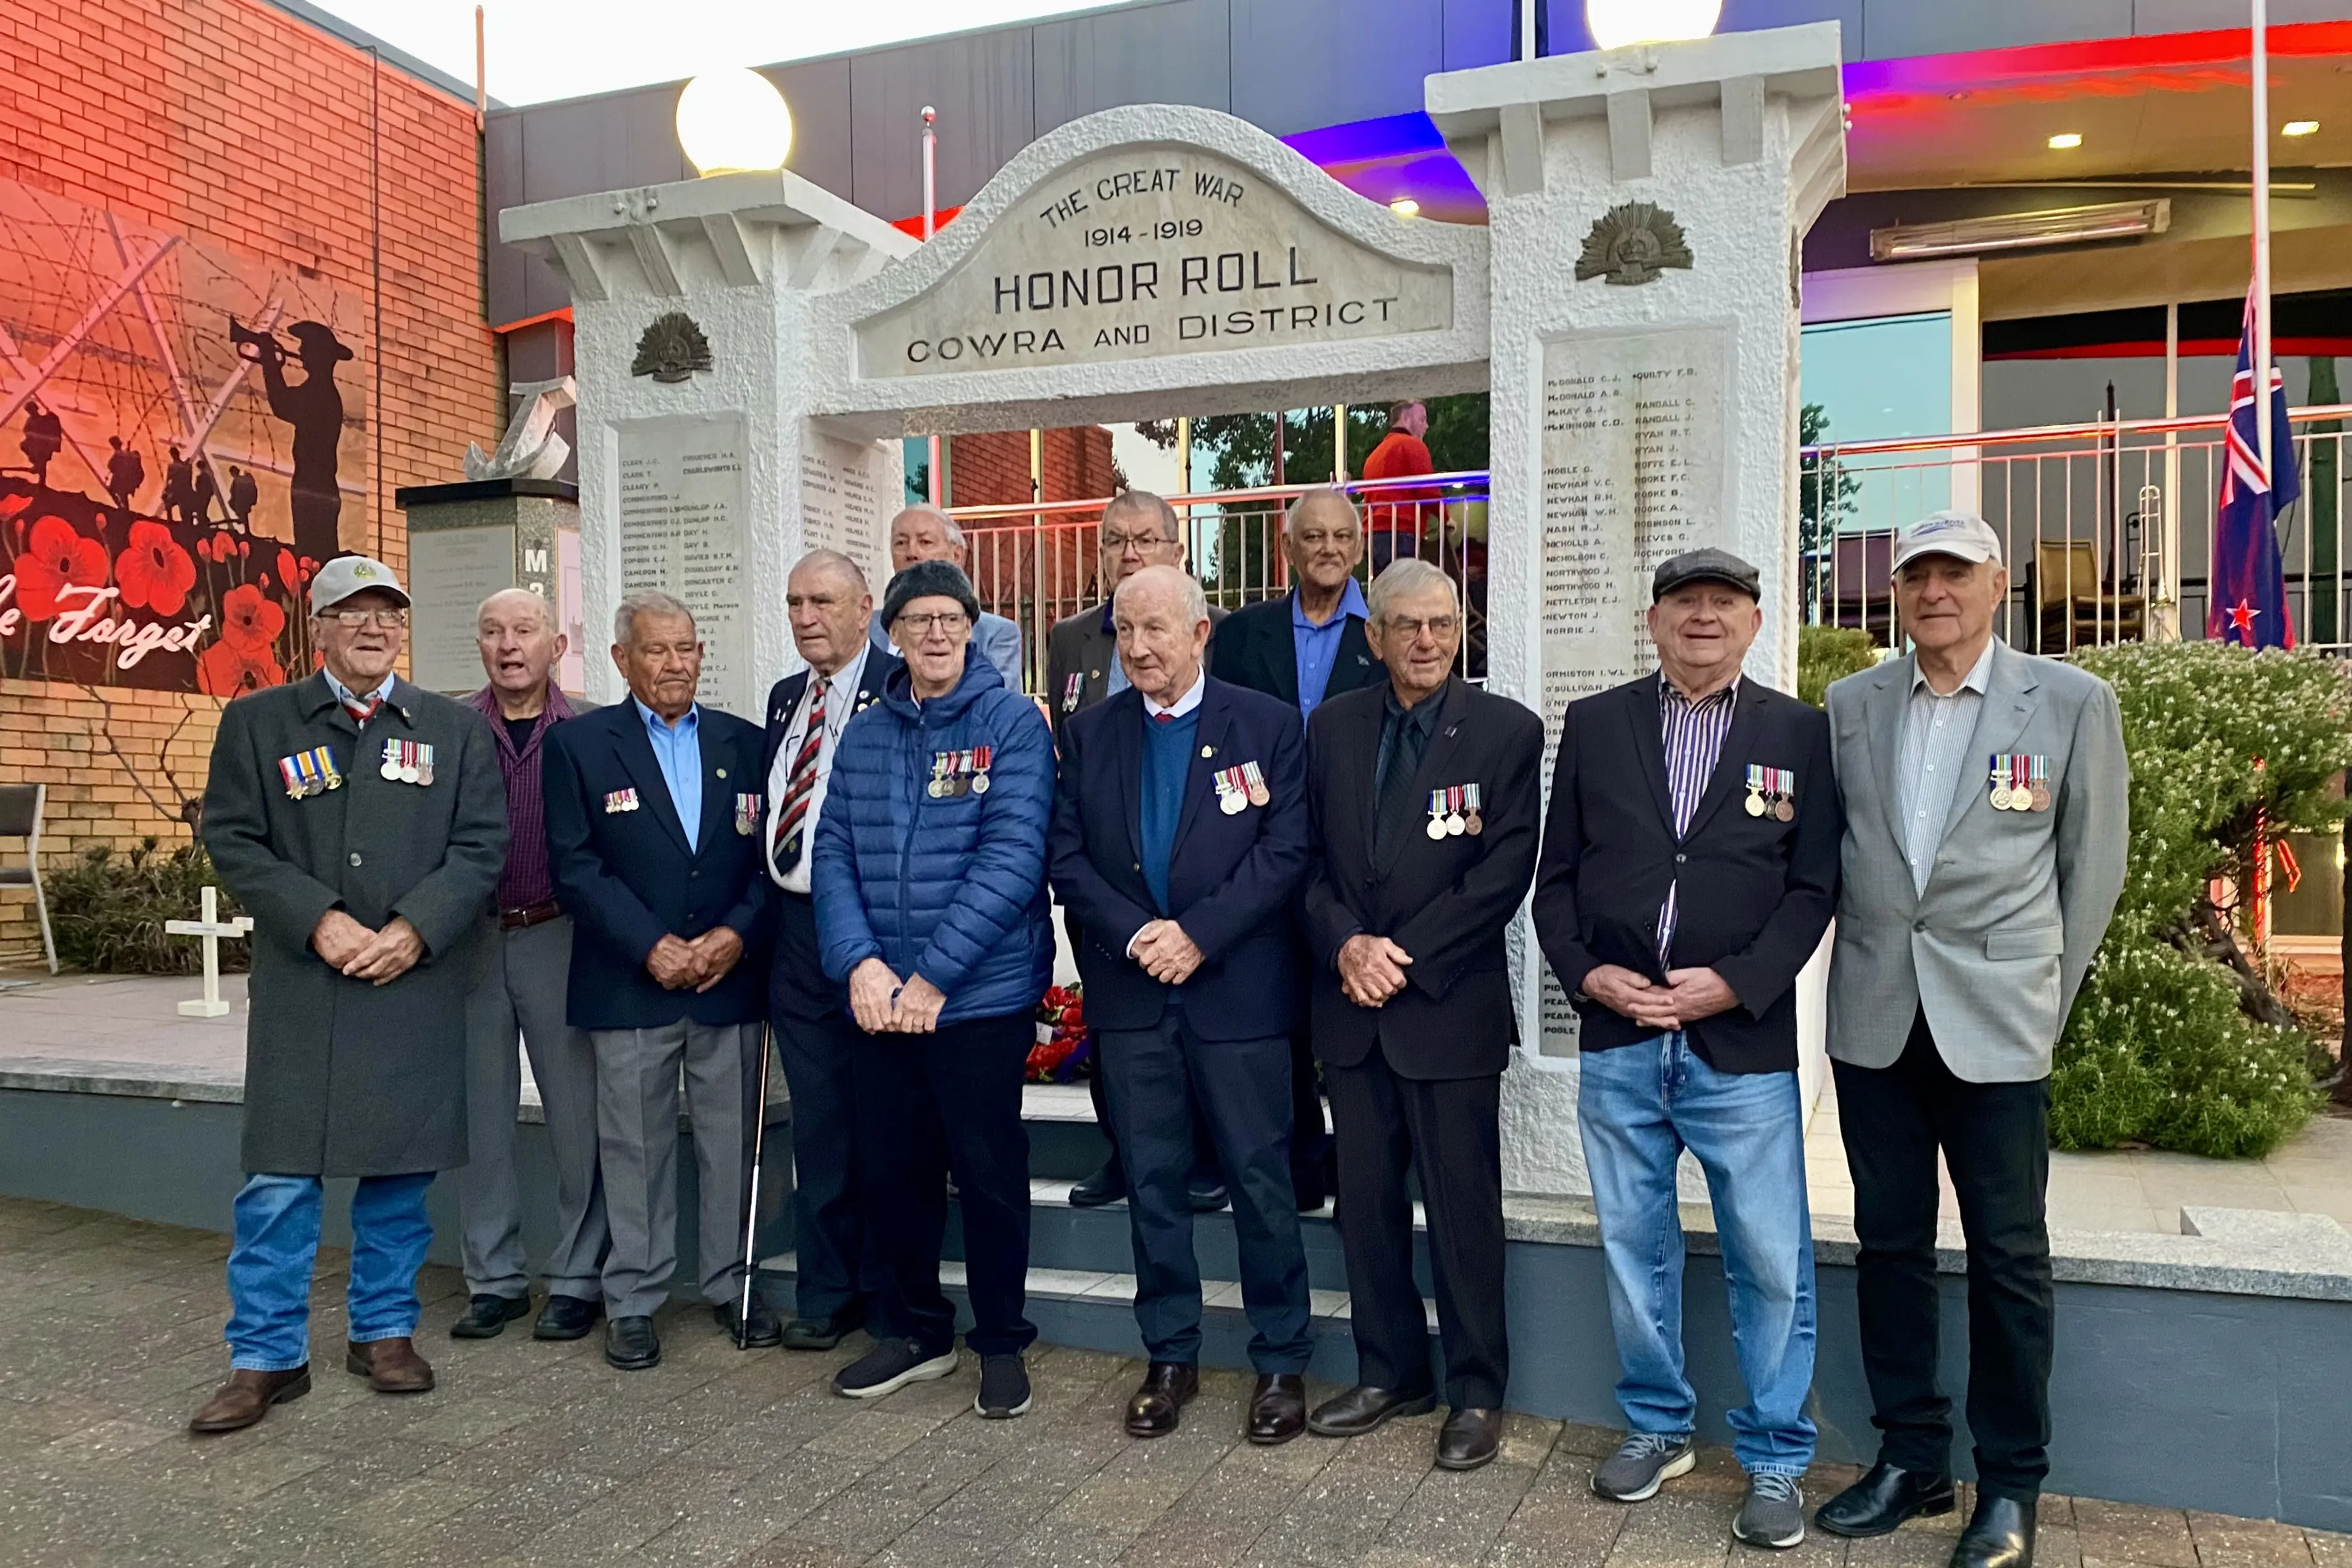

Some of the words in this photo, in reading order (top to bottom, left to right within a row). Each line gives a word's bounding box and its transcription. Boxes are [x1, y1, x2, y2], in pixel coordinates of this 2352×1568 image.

[1039, 190, 1089, 230] THE
[1097, 168, 1181, 202] GREAT
[1194, 171, 1245, 208] WAR
[994, 262, 1158, 315] HONOR
[1181, 247, 1318, 296] ROLL
[907, 329, 1065, 364] COWRA
[1094, 324, 1150, 347] AND
[1179, 297, 1399, 341] DISTRICT
[525, 549, 547, 573] M
[1546, 582, 1600, 592] NORTHWOOD
[49, 582, 212, 670] Forget
[1546, 669, 1594, 678] ORMISTON
[1546, 684, 1602, 693] O'SULLIVAN
